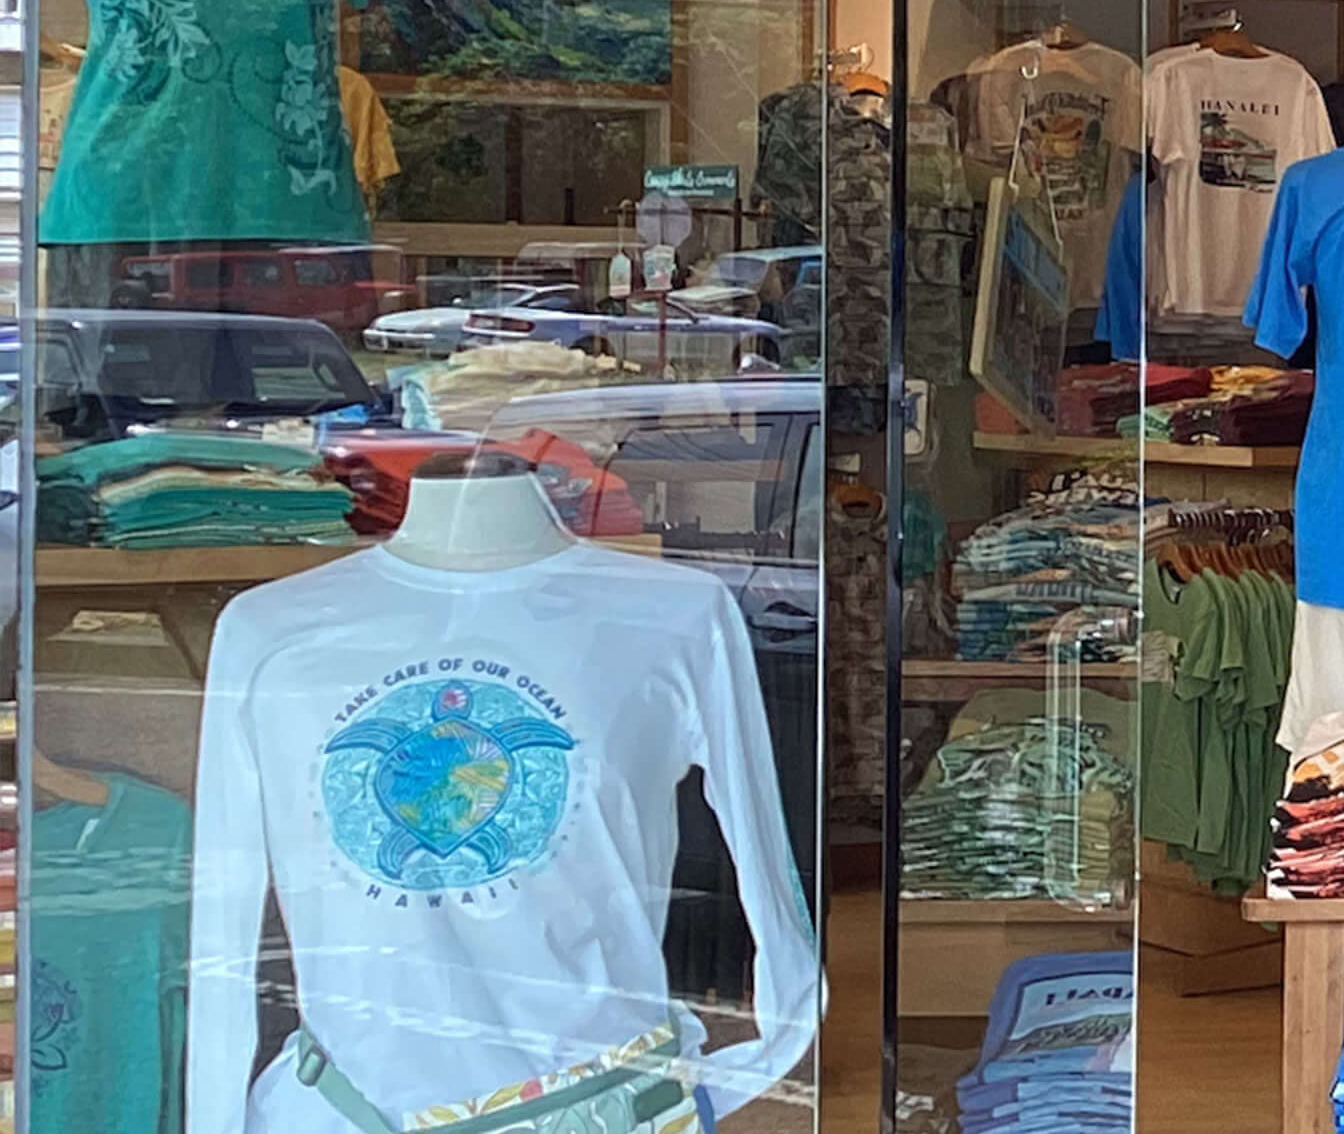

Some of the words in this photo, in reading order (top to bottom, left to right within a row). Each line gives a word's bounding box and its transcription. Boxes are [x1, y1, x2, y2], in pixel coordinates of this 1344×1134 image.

[1200, 99, 1280, 116] HANALEI
[333, 685, 378, 724] TAKE
[382, 659, 430, 688] CARE
[437, 657, 464, 672] OF
[471, 658, 511, 679] OUR
[515, 674, 567, 720] OCEAN
